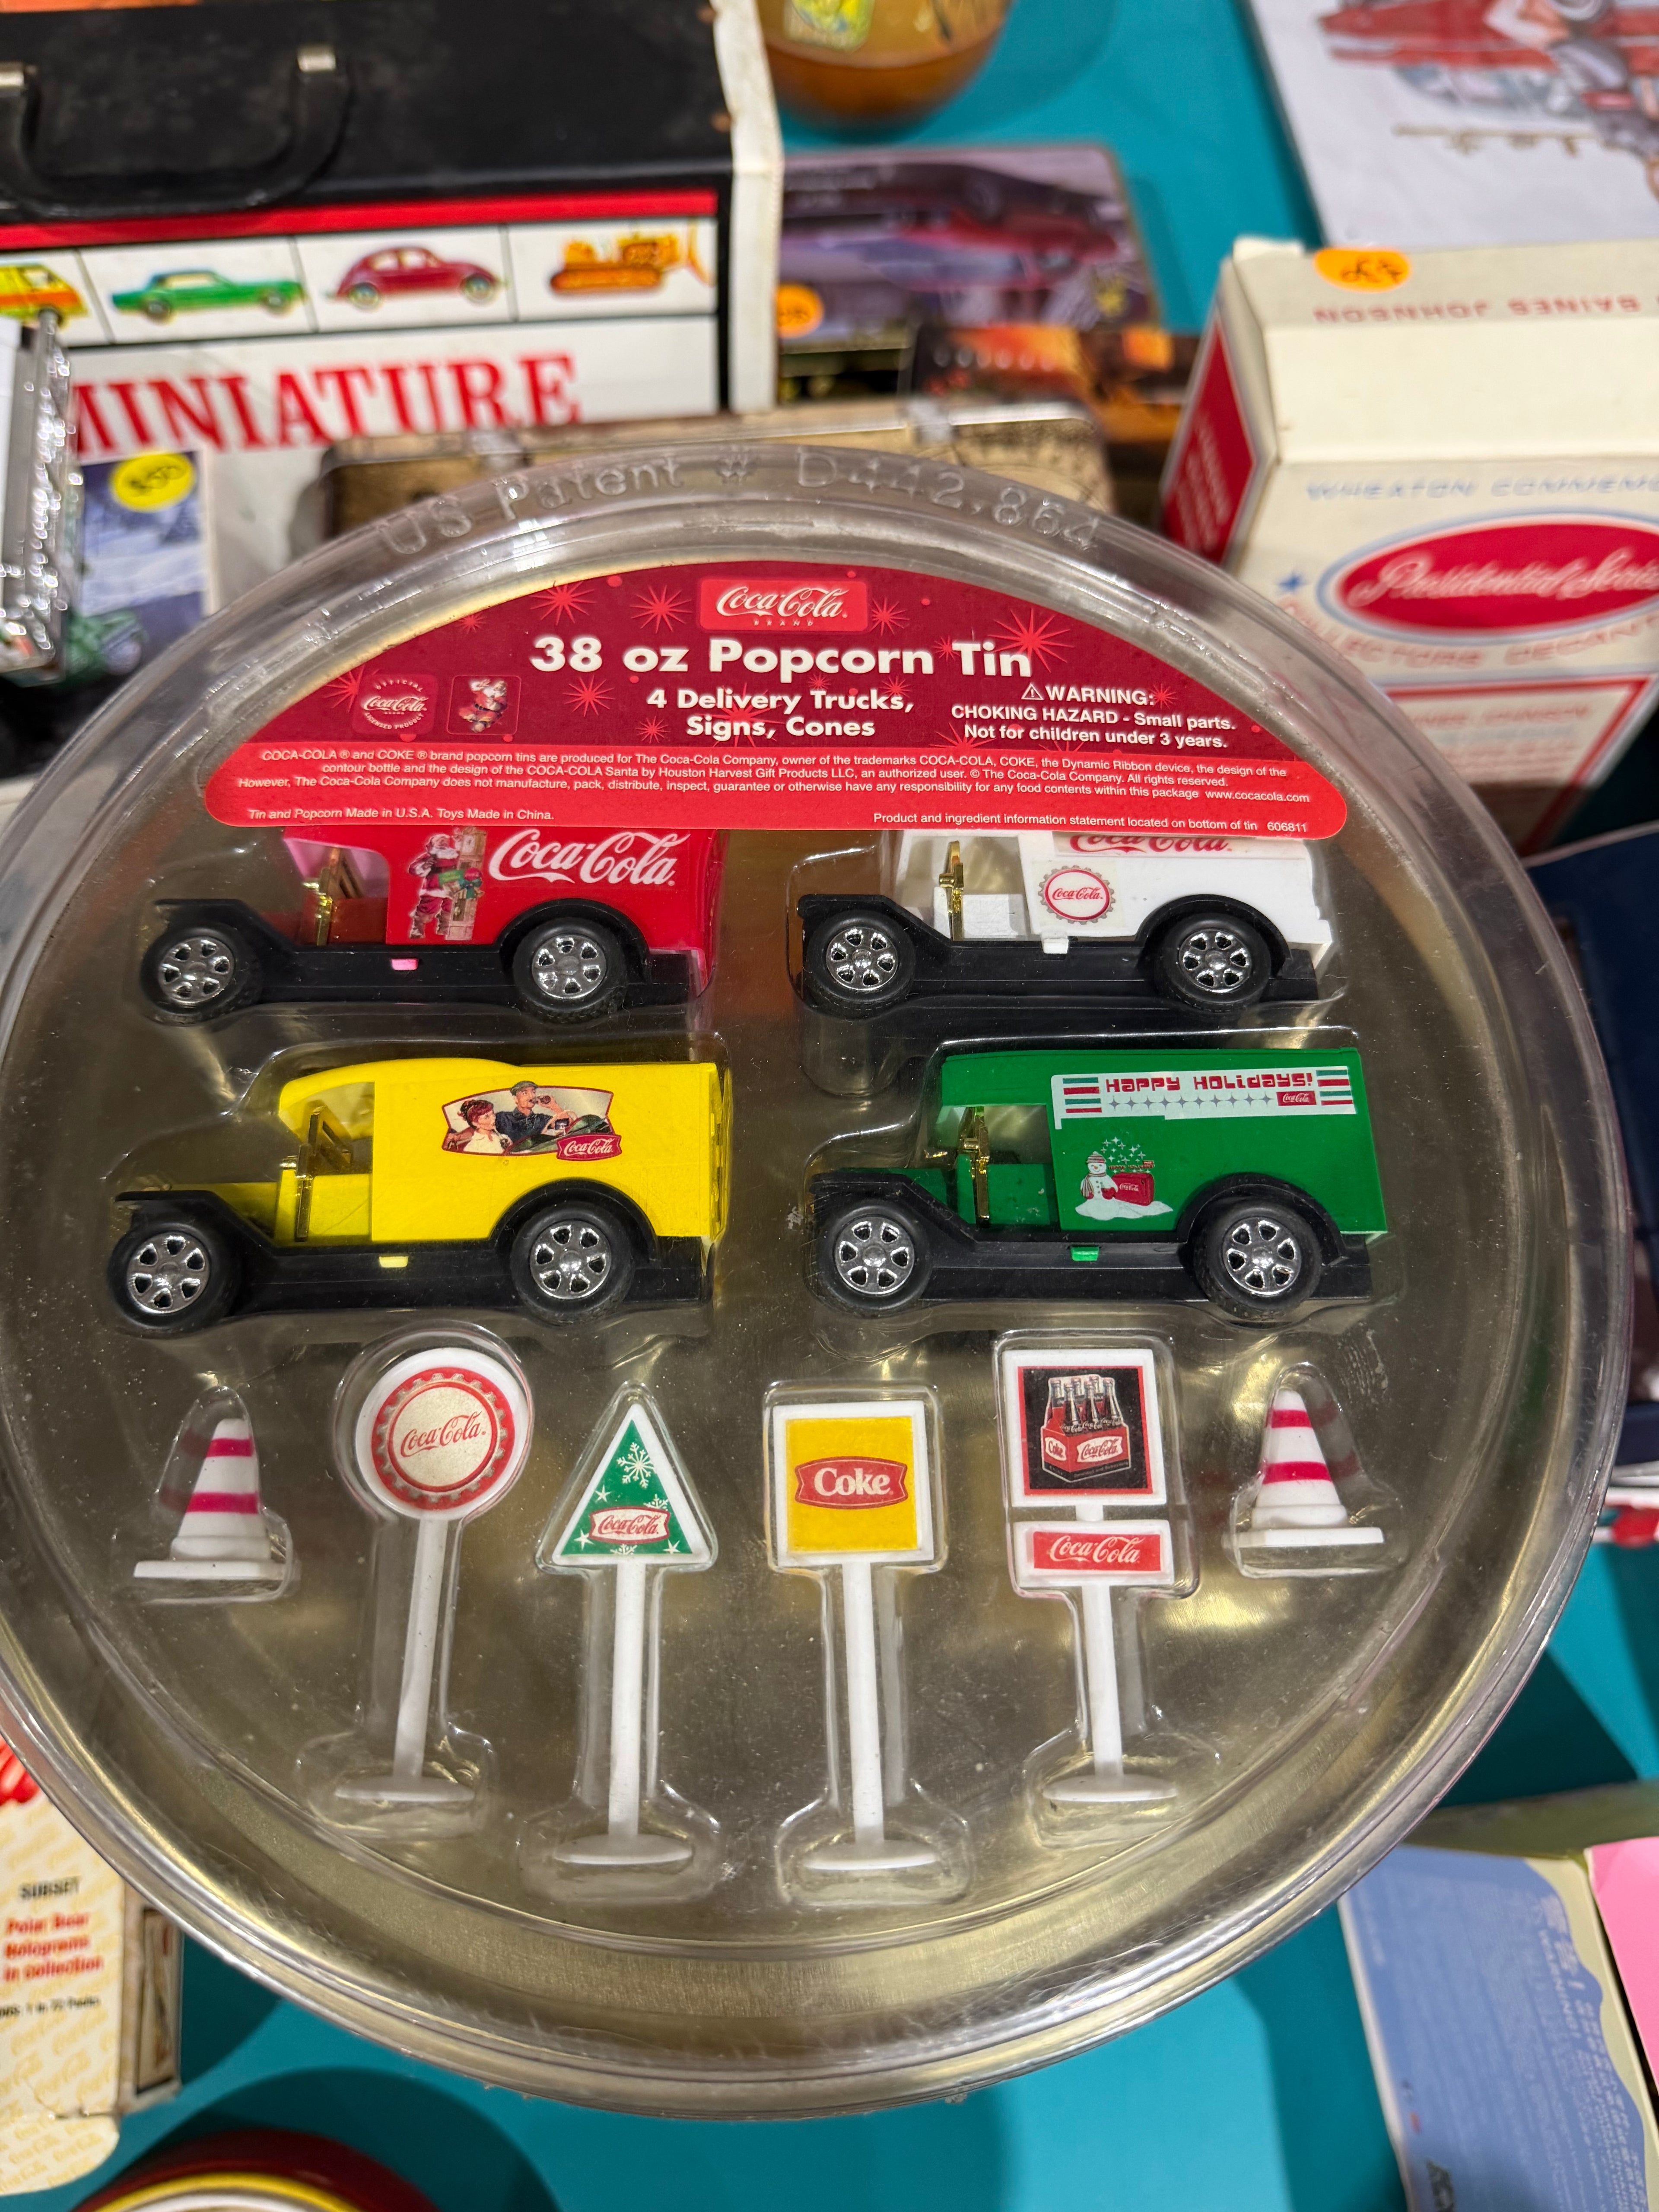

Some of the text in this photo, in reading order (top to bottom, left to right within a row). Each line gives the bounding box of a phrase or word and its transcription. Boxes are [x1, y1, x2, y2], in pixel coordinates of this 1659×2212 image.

[1315, 301, 1493, 323] JOHNSON
[496, 455, 683, 520] Patent
[716, 585, 849, 619] Coca-Cola
[530, 636, 1032, 683] 38 oz Popcorn Tin
[363, 696, 429, 711] Coca-Cola
[647, 689, 914, 715] 4 Delivery Trucks,
[1046, 686, 1155, 706] WARNING:
[365, 712, 424, 729] LICENSED PRODUCT
[686, 715, 875, 741] Signs, Cones
[952, 706, 1036, 721] CHOKING
[1042, 707, 1118, 725] HAZARD
[1134, 712, 1182, 728] Small
[1187, 716, 1236, 732] parts.
[965, 725, 1228, 750] Not for children under 3 years.
[262, 751, 337, 760] COCA-COLA
[352, 750, 374, 759] and
[377, 750, 414, 759] COKE
[430, 750, 463, 760] brand
[465, 753, 512, 763] popcorn
[515, 752, 536, 762] tins
[539, 754, 558, 762] are
[560, 753, 614, 764] produced
[617, 753, 632, 763] for
[635, 753, 657, 763] The
[660, 754, 719, 764] Coca-Cola
[722, 754, 778, 766] Company,
[819, 755, 830, 764] of
[833, 755, 851, 764] the
[854, 755, 916, 764] trademarks
[919, 755, 996, 767] COCA-COLA,
[1000, 756, 1038, 768] COKE,
[1041, 757, 1059, 767] the
[1062, 758, 1110, 770] Dynamic
[1113, 760, 1152, 771] Ribbon
[1155, 762, 1193, 773] device,
[1196, 764, 1214, 773] the
[1217, 765, 1253, 777] design
[1256, 766, 1267, 775] of
[1269, 767, 1287, 776] the
[321, 764, 366, 772] contour
[368, 763, 400, 772] bottle
[402, 764, 425, 772] and
[429, 764, 447, 773] the
[449, 765, 488, 775] design
[490, 766, 503, 774] of
[505, 766, 524, 774] the
[527, 766, 602, 775] COCA-COLA
[605, 767, 638, 776] Santa
[642, 767, 655, 779] by
[658, 767, 705, 777] Houston
[709, 768, 752, 778] Harvest
[756, 768, 775, 778] Gift
[779, 768, 828, 778] Products
[832, 768, 857, 779] LLC,
[878, 769, 937, 778] authorized
[982, 769, 1004, 779] The
[1007, 769, 1066, 780] Coca-Cola
[1069, 772, 1124, 784] Company.
[1127, 774, 1141, 782] All
[1144, 775, 1174, 785] rights
[1177, 778, 1228, 786] reserved.
[238, 778, 290, 787] However,
[294, 775, 317, 786] The
[319, 776, 380, 786] Coca-Cola
[382, 776, 440, 788] Company
[441, 778, 471, 787] does
[474, 779, 493, 787] not
[495, 779, 570, 790] manufacture,
[573, 780, 604, 791] pack,
[607, 780, 663, 791] distribute,
[667, 781, 709, 792] inspect,
[713, 782, 770, 793] guarantee
[788, 782, 842, 791] otherwise
[845, 782, 872, 791] have
[876, 784, 896, 793] any
[900, 782, 973, 794] responsibility
[975, 782, 990, 791] for
[993, 785, 1014, 794] any
[1017, 783, 1041, 792] food
[1045, 785, 1092, 794] contents
[1094, 786, 1126, 795] within
[1129, 787, 1149, 796] this
[1152, 788, 1199, 800] package
[1205, 791, 1311, 802] www.cocacola.com
[247, 807, 554, 820] Tin and Popcorn Made in U.S.A. Toys Made in China.
[874, 813, 917, 823] Product
[921, 813, 941, 823] and
[945, 813, 1001, 825] ingredient
[1004, 814, 1066, 824] information
[1070, 816, 1125, 826] statement
[1128, 817, 1169, 827] located
[1188, 819, 1227, 829] bottom
[1230, 820, 1241, 829] of
[1243, 820, 1258, 830] tin
[1267, 821, 1306, 832] 606811
[488, 829, 691, 886] Coca-Cola
[1052, 887, 1103, 900] Coca-Cola
[1282, 1093, 1310, 1103] Coca-Cola
[563, 1138, 615, 1157] Coca-Cola
[400, 1411, 486, 1458] Coca-Cola
[1081, 1438, 1119, 1460] Coca-Cola
[814, 1467, 892, 1496] Coke
[598, 1514, 660, 1535] Coca-Cola
[1049, 1535, 1144, 1564] Coca-Cola
